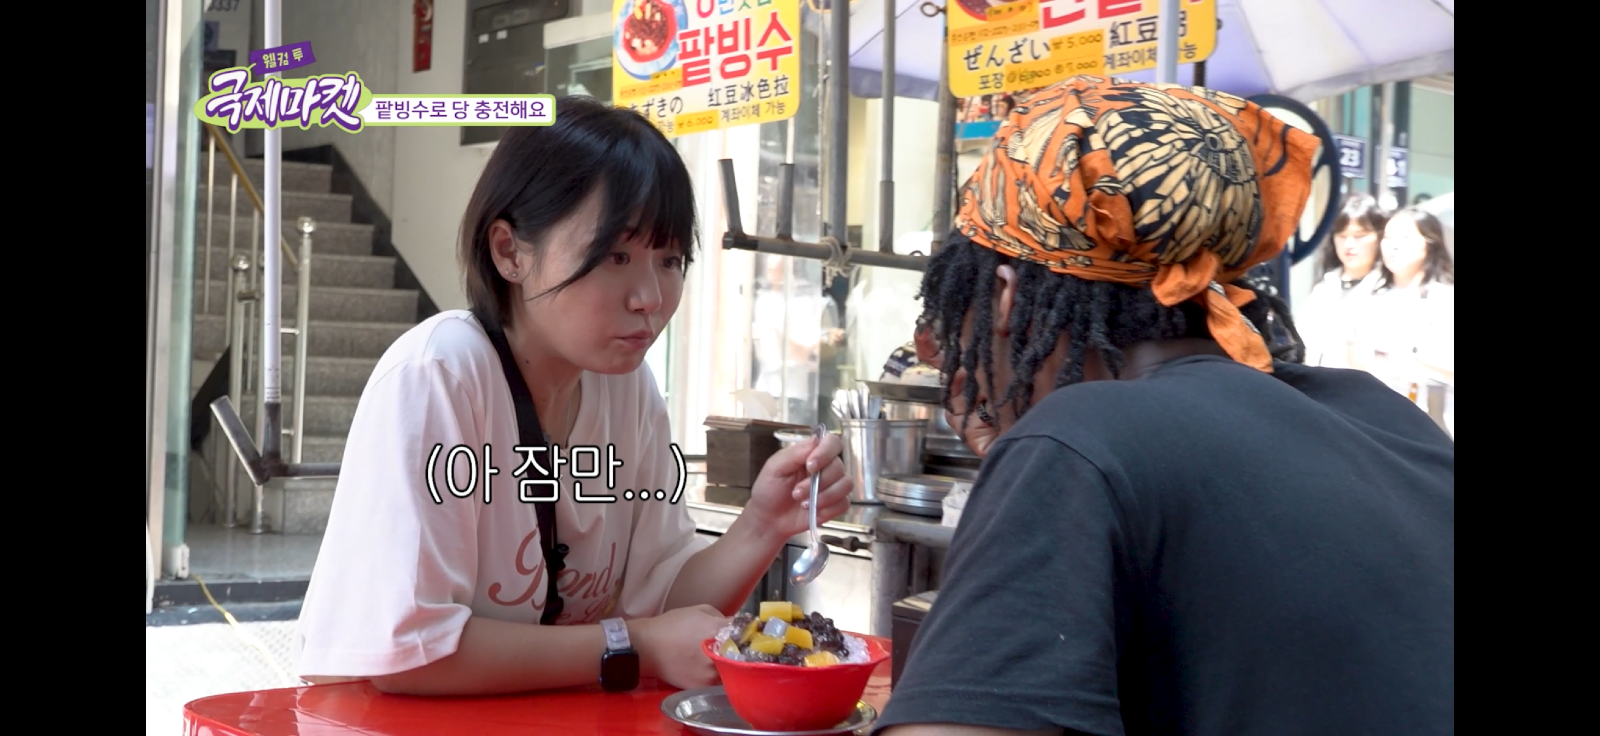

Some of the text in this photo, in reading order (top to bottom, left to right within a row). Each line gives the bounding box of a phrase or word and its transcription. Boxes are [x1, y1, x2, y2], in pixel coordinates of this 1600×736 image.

[678, 11, 793, 88] 팥빙수
[963, 37, 1051, 71] ぜんざい
[979, 71, 1005, 90] 포장
[630, 96, 684, 120] ずきの
[765, 100, 786, 116] 가능
[1340, 147, 1361, 168] 23
